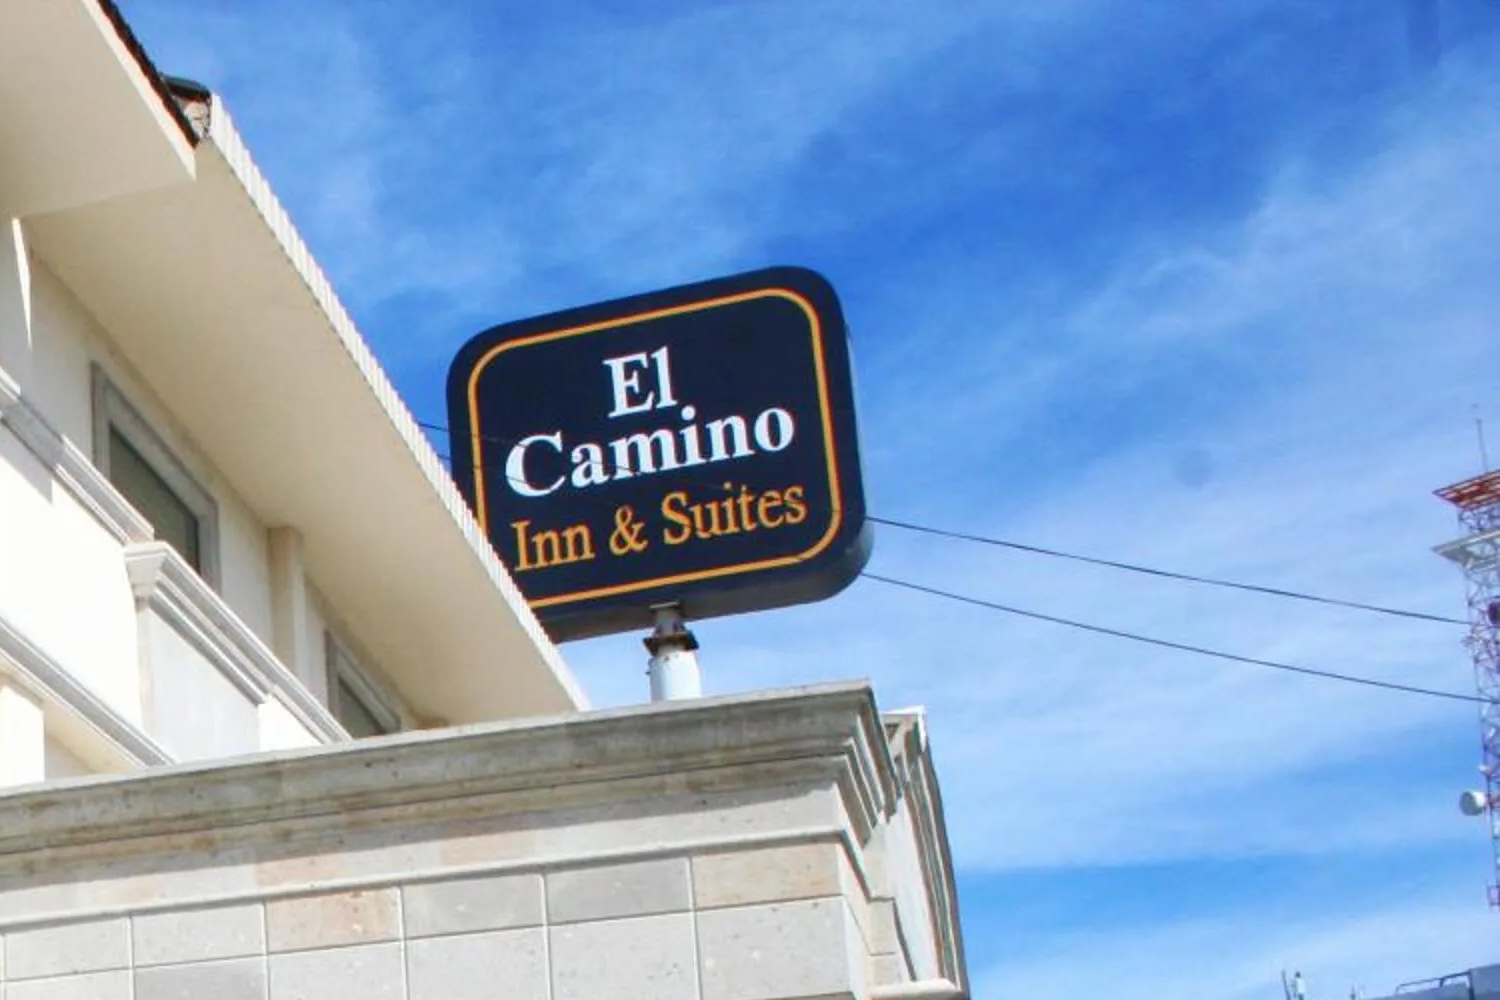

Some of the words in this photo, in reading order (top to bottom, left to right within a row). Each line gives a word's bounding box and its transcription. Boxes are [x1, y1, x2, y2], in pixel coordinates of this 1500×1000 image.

[603, 346, 678, 419] El
[504, 404, 795, 498] Camino
[511, 517, 596, 572] Inn
[607, 504, 648, 556] &
[661, 481, 808, 546] Suites
